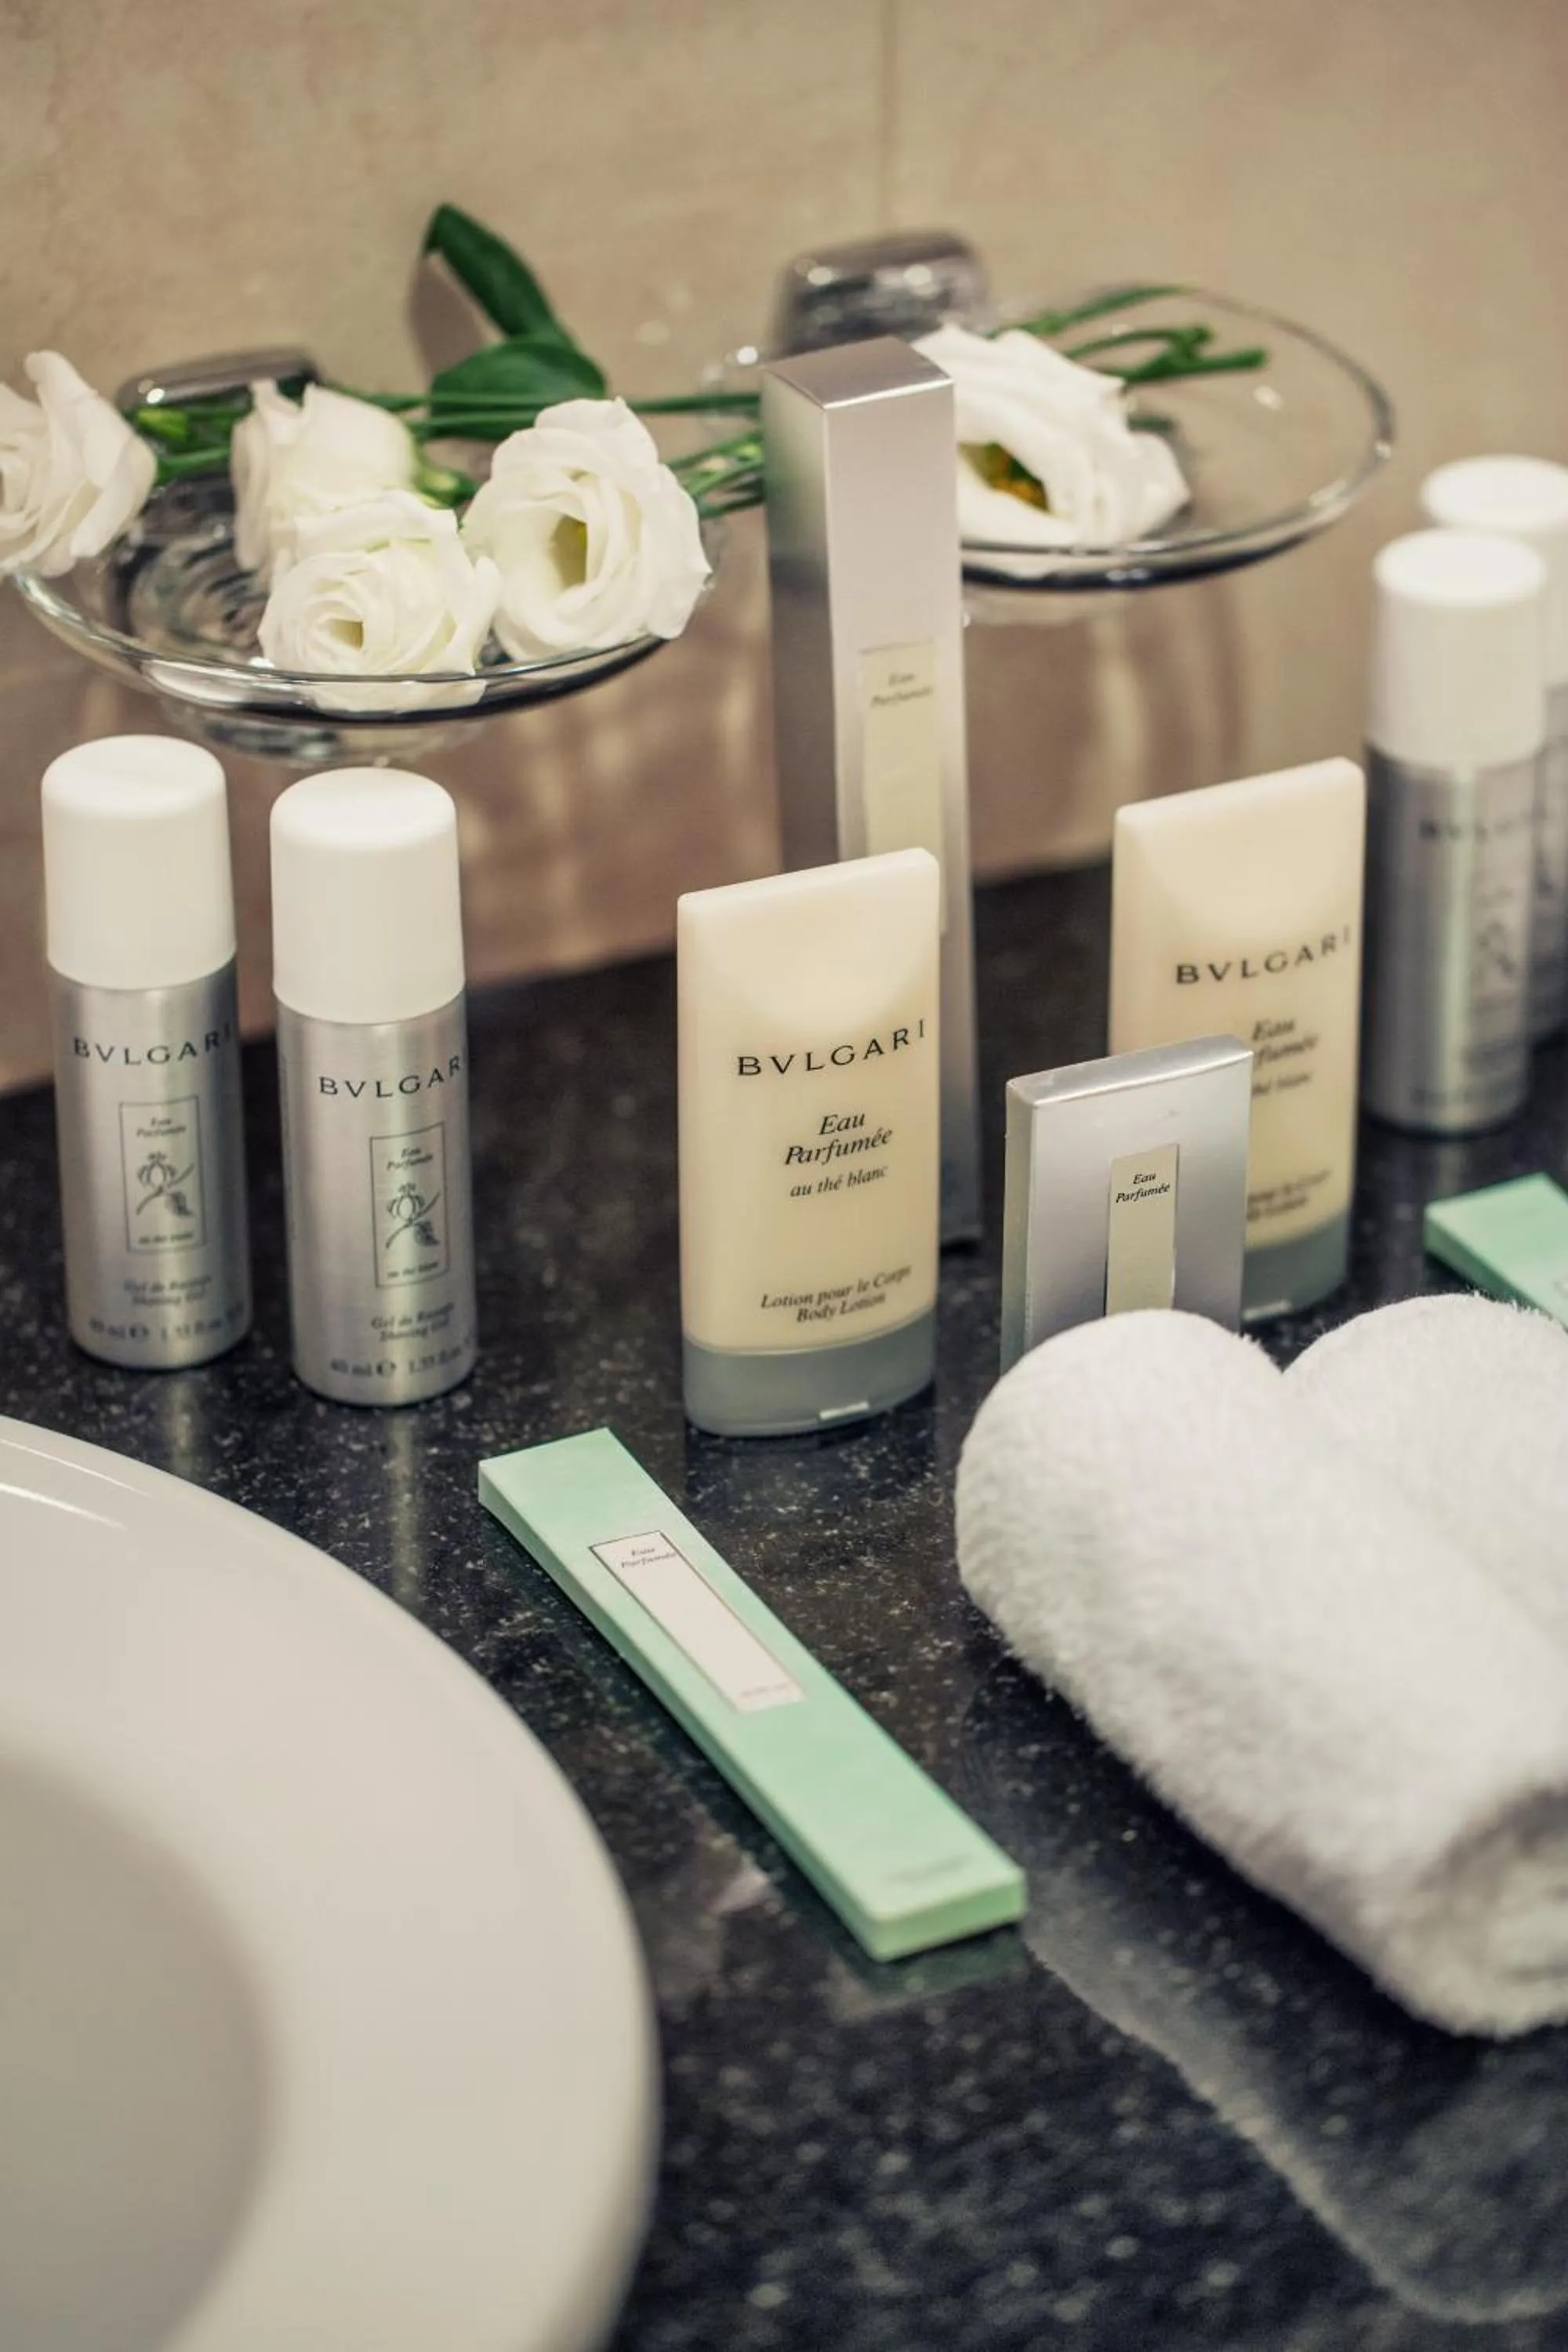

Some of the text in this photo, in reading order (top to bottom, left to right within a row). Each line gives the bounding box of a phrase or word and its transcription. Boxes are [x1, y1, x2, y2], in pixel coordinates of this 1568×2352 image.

[1176, 924, 1350, 985] BVLGARI
[74, 1022, 230, 1065] BVLGARI
[738, 1019, 925, 1076] BVLGARI
[318, 1055, 463, 1098] BVLGAR
[817, 1113, 866, 1135] Eau
[784, 1127, 893, 1166] Parfumée
[790, 1166, 887, 1196] au thé blanc
[1116, 1182, 1171, 1203] Parfumée
[1133, 1173, 1156, 1185] Eau
[761, 1265, 912, 1308] Lotion pour le Corps
[797, 1293, 886, 1323] Body Lotion
